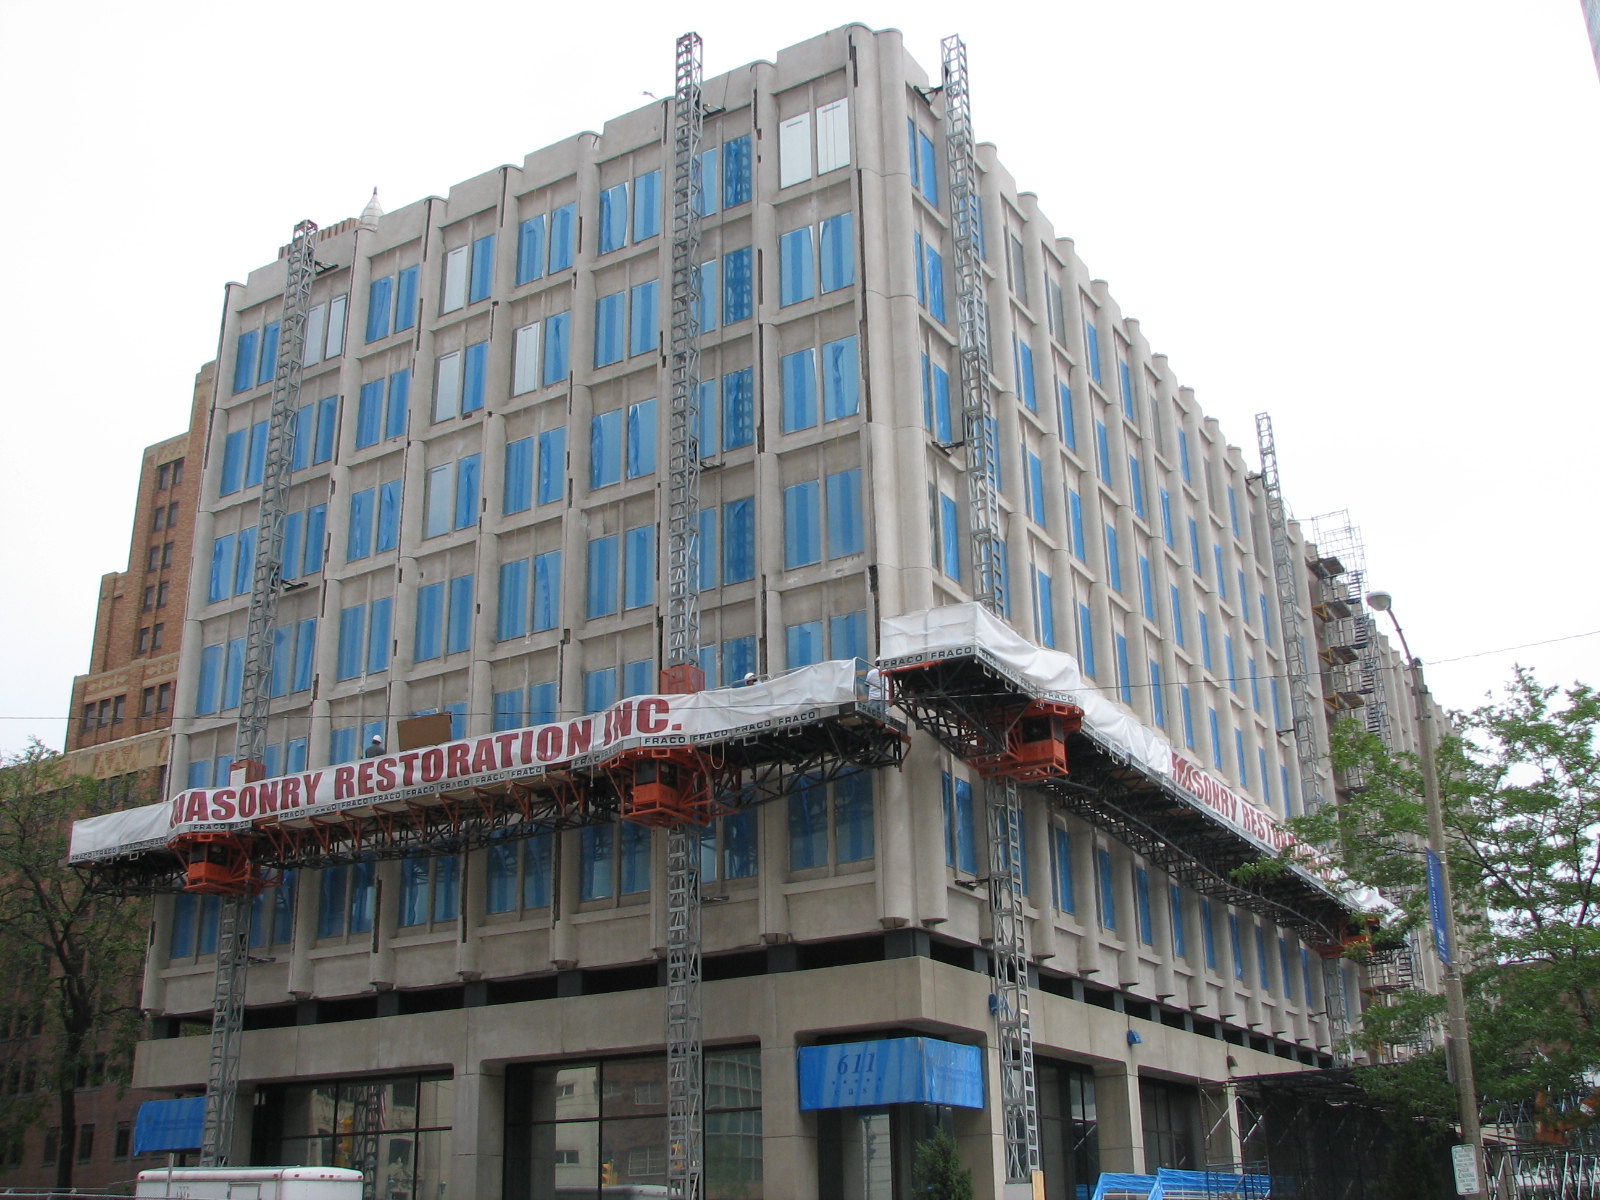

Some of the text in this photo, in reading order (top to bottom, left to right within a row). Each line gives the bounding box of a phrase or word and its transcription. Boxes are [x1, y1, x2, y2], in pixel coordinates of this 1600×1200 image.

[931, 646, 972, 660] FRACO
[883, 654, 923, 668] FRACO
[1043, 691, 1074, 702] FRACO
[858, 702, 882, 719] FRACO
[779, 711, 816, 725] FRACO
[736, 720, 771, 733] FRACO
[645, 736, 686, 745] FRACO
[693, 730, 728, 742] FRACO
[601, 744, 621, 759] FRACO
[170, 698, 682, 829] MASONRY RESTORATION INC.
[575, 755, 601, 766] FRAC
[511, 766, 542, 778] FRACO
[406, 786, 434, 796] FRACO
[441, 780, 470, 790] FRACO
[1172, 752, 1237, 822] MASONRY
[342, 798, 369, 809] FRACO
[373, 793, 400, 803] FRACO
[280, 810, 305, 820] FRACO
[96, 847, 117, 857] FRACO
[838, 1052, 875, 1075] 611
